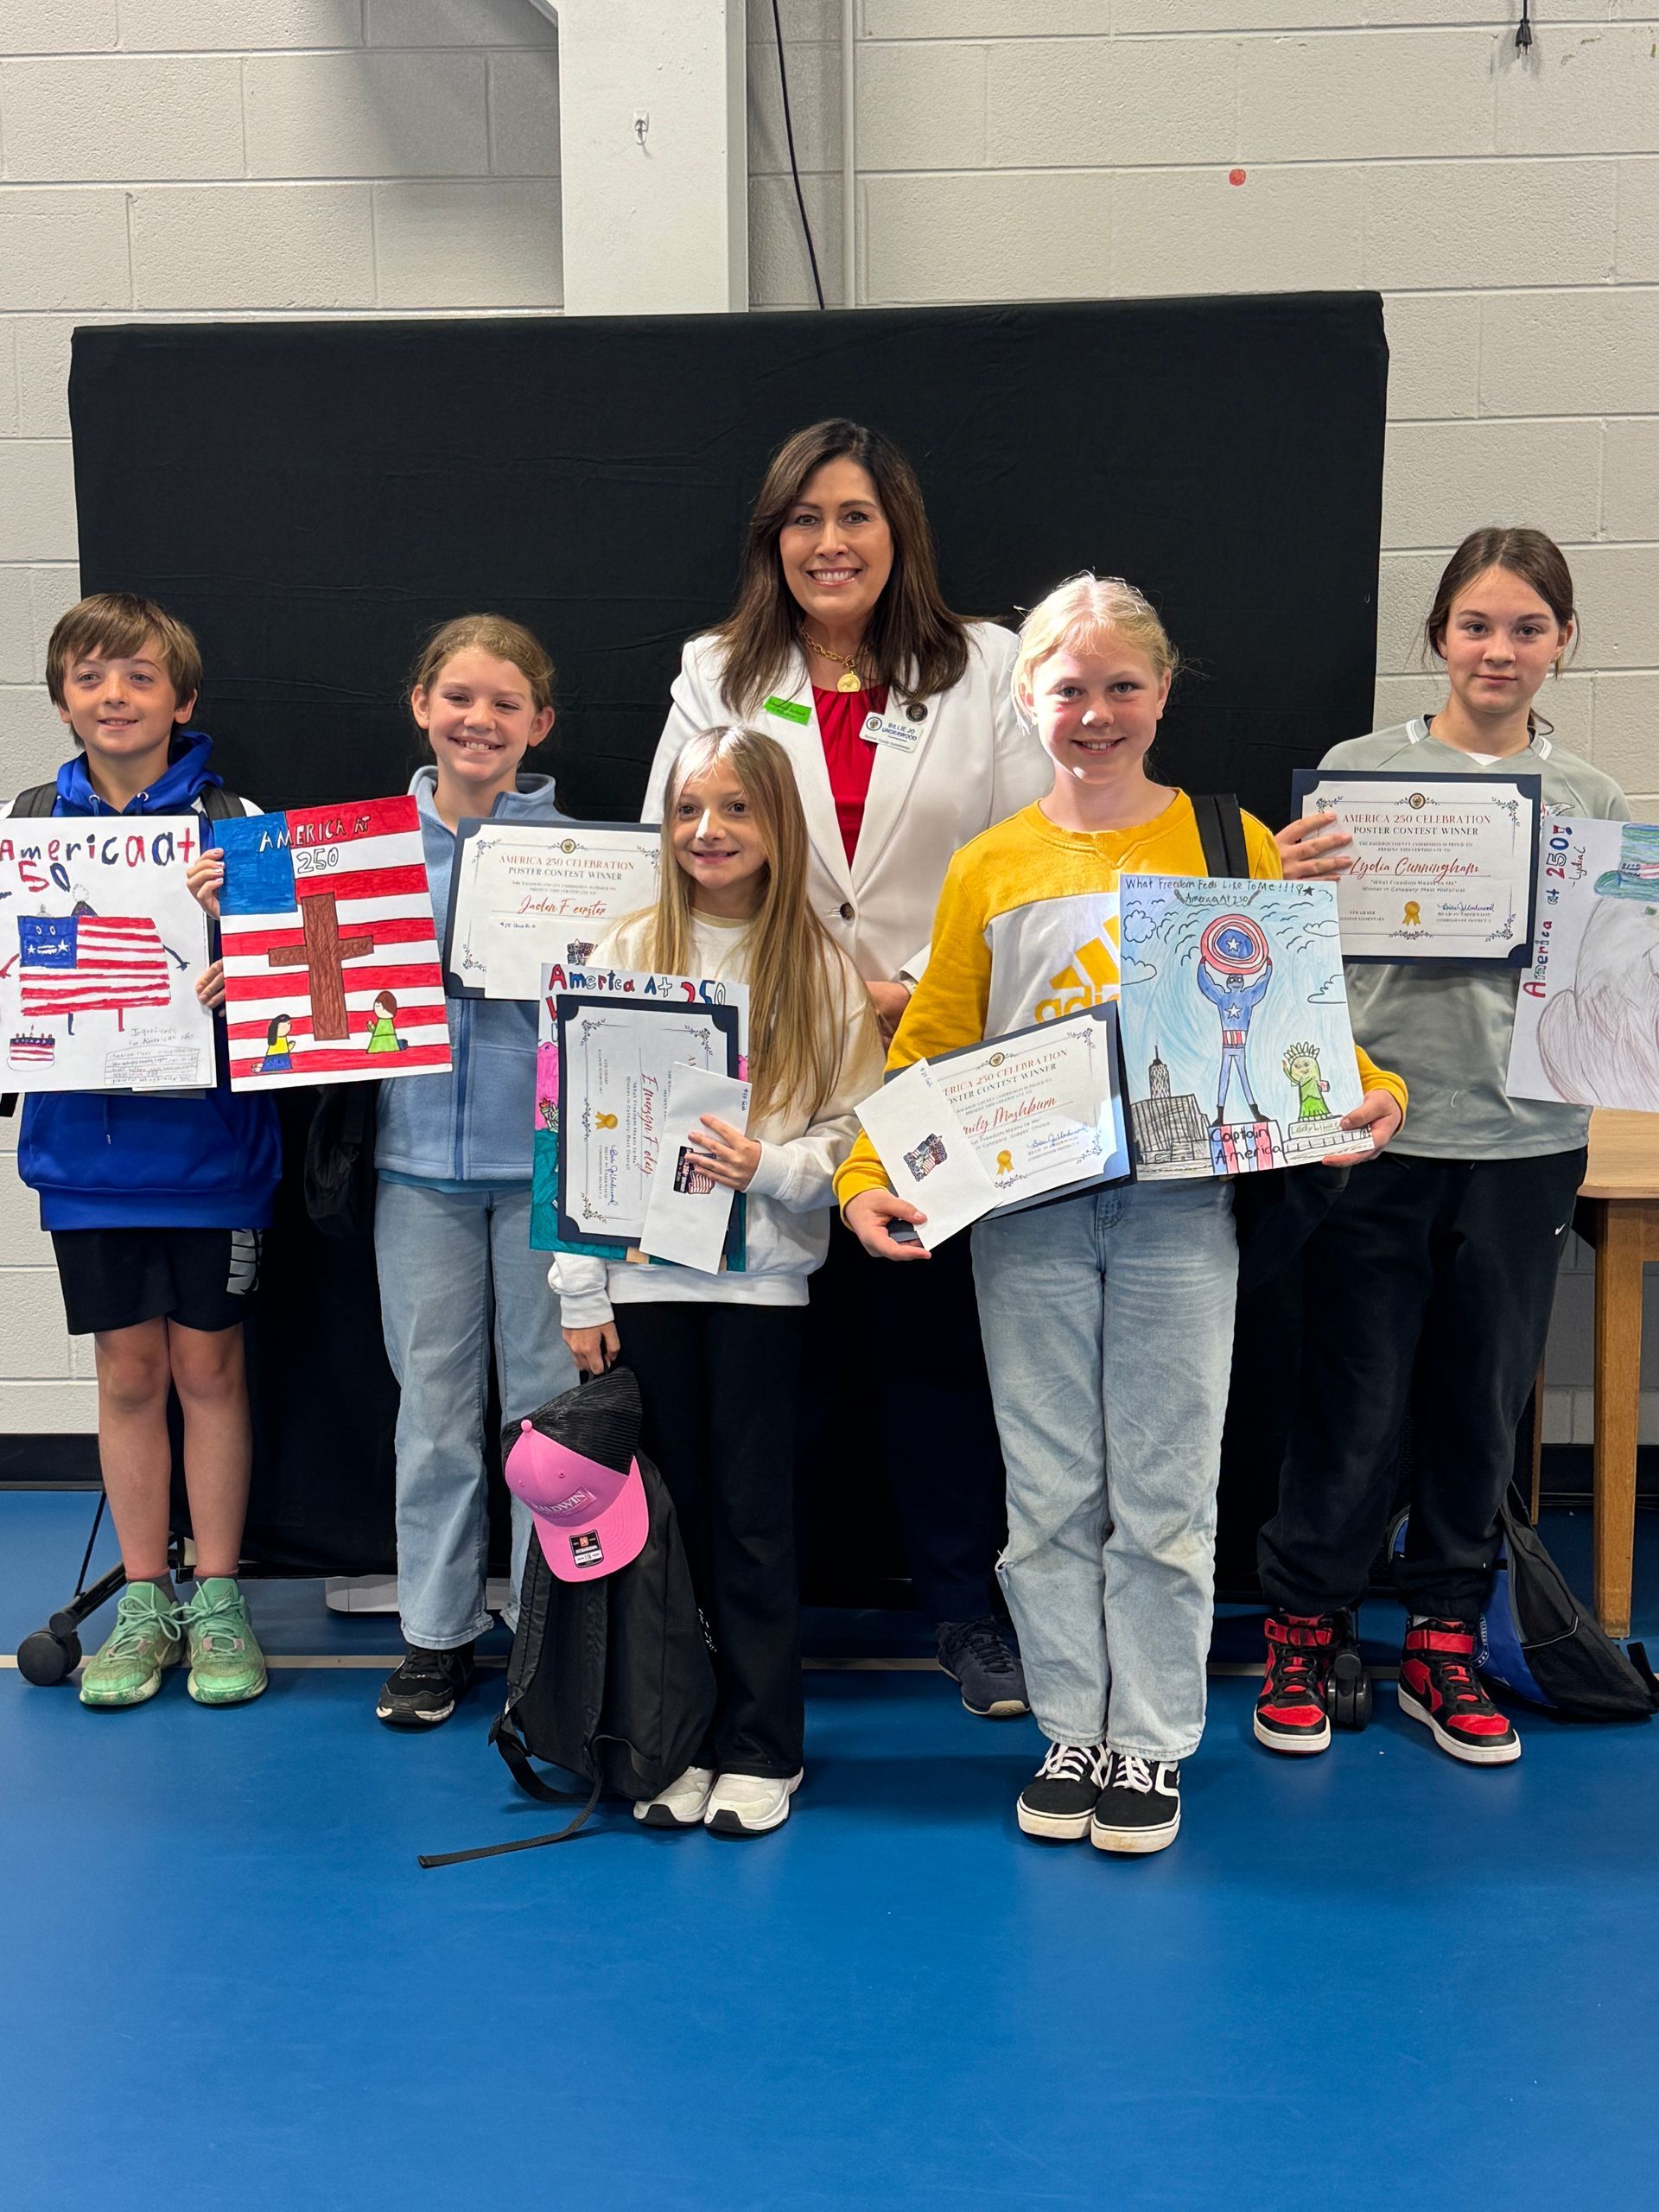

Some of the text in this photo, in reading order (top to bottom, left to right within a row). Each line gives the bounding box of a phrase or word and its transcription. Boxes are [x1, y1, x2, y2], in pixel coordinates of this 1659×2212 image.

[881, 728, 918, 741] UNDERWOOD
[888, 723, 906, 733] BILLIE
[1415, 815, 1491, 823] CELEBRATION
[258, 815, 372, 853] AMERICA AT
[1353, 826, 1478, 836] POSTER CONTEST WINNER
[296, 846, 340, 874] 250
[499, 855, 635, 871] AMERICA 250 CELEBRATION
[1350, 856, 1480, 883] Lydia Cunningham
[508, 867, 622, 880] POSTER CONTEST WINNER
[1127, 879, 1153, 888] What
[1223, 881, 1243, 890] Like
[1248, 881, 1256, 891] To
[518, 895, 557, 915] Jaden
[1522, 920, 1554, 998] America
[1545, 887, 1560, 906] at
[549, 963, 635, 992] America
[644, 976, 673, 998] At
[976, 1074, 995, 1086] 250
[996, 1049, 1067, 1078] CELEBRATION
[977, 1077, 1017, 1095] CONTEST
[1021, 1063, 1057, 1080] WINNER
[993, 1096, 1058, 1127] Mashburn
[1211, 1125, 1269, 1144] Captain
[636, 1136, 659, 1177] Foley
[1216, 1145, 1283, 1165] America
